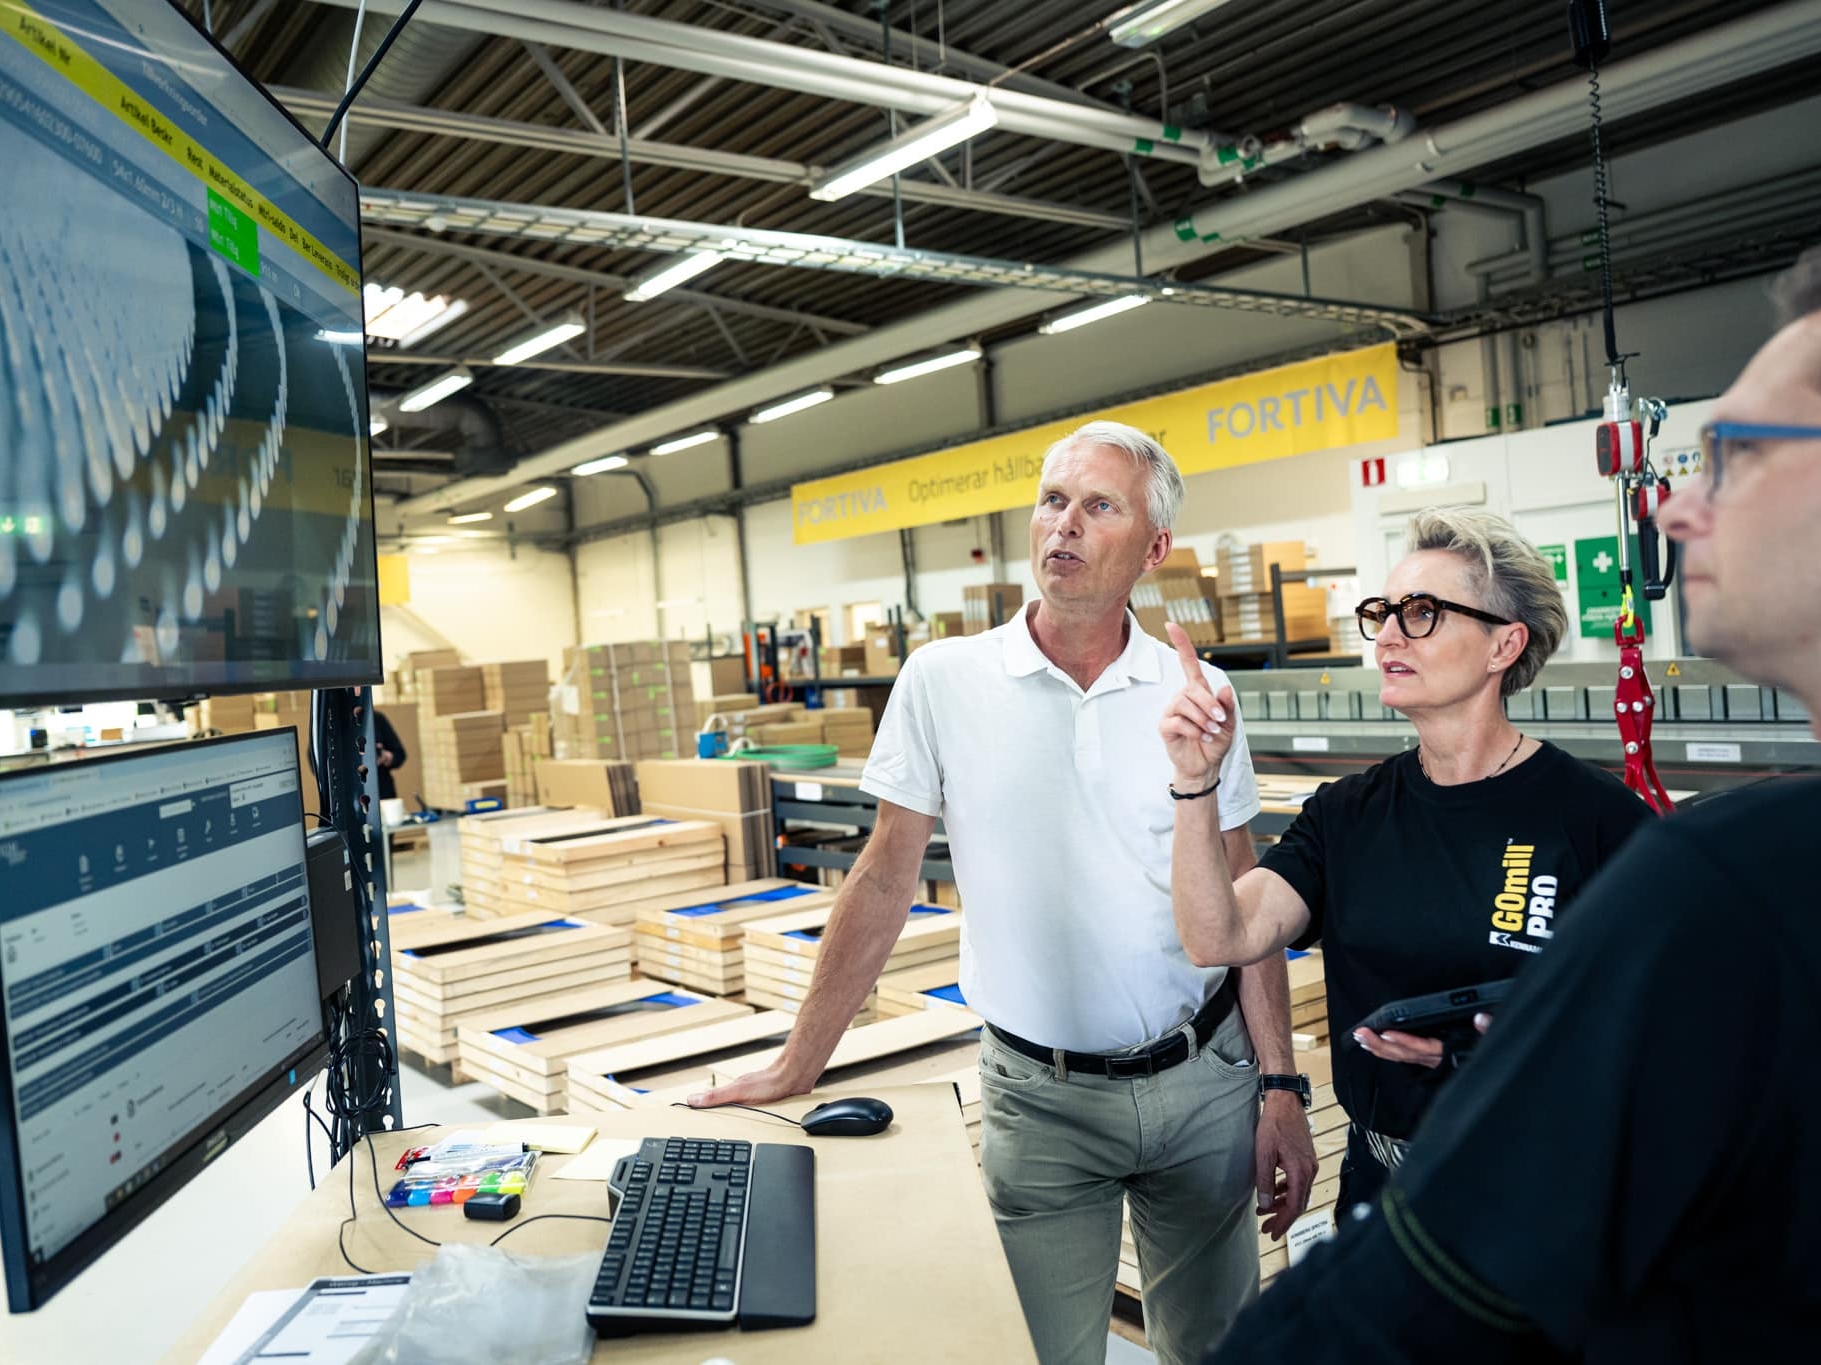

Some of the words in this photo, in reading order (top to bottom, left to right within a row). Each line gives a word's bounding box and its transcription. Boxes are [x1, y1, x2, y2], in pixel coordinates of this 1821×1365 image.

[121, 96, 149, 128] Artikel
[798, 486, 889, 527] FORTIVA
[908, 468, 989, 505] Optimerar
[992, 454, 1044, 484] hållba
[1206, 375, 1387, 445] FORTIVA
[1491, 845, 1535, 932] GOmill
[1526, 875, 1557, 939] PRO
